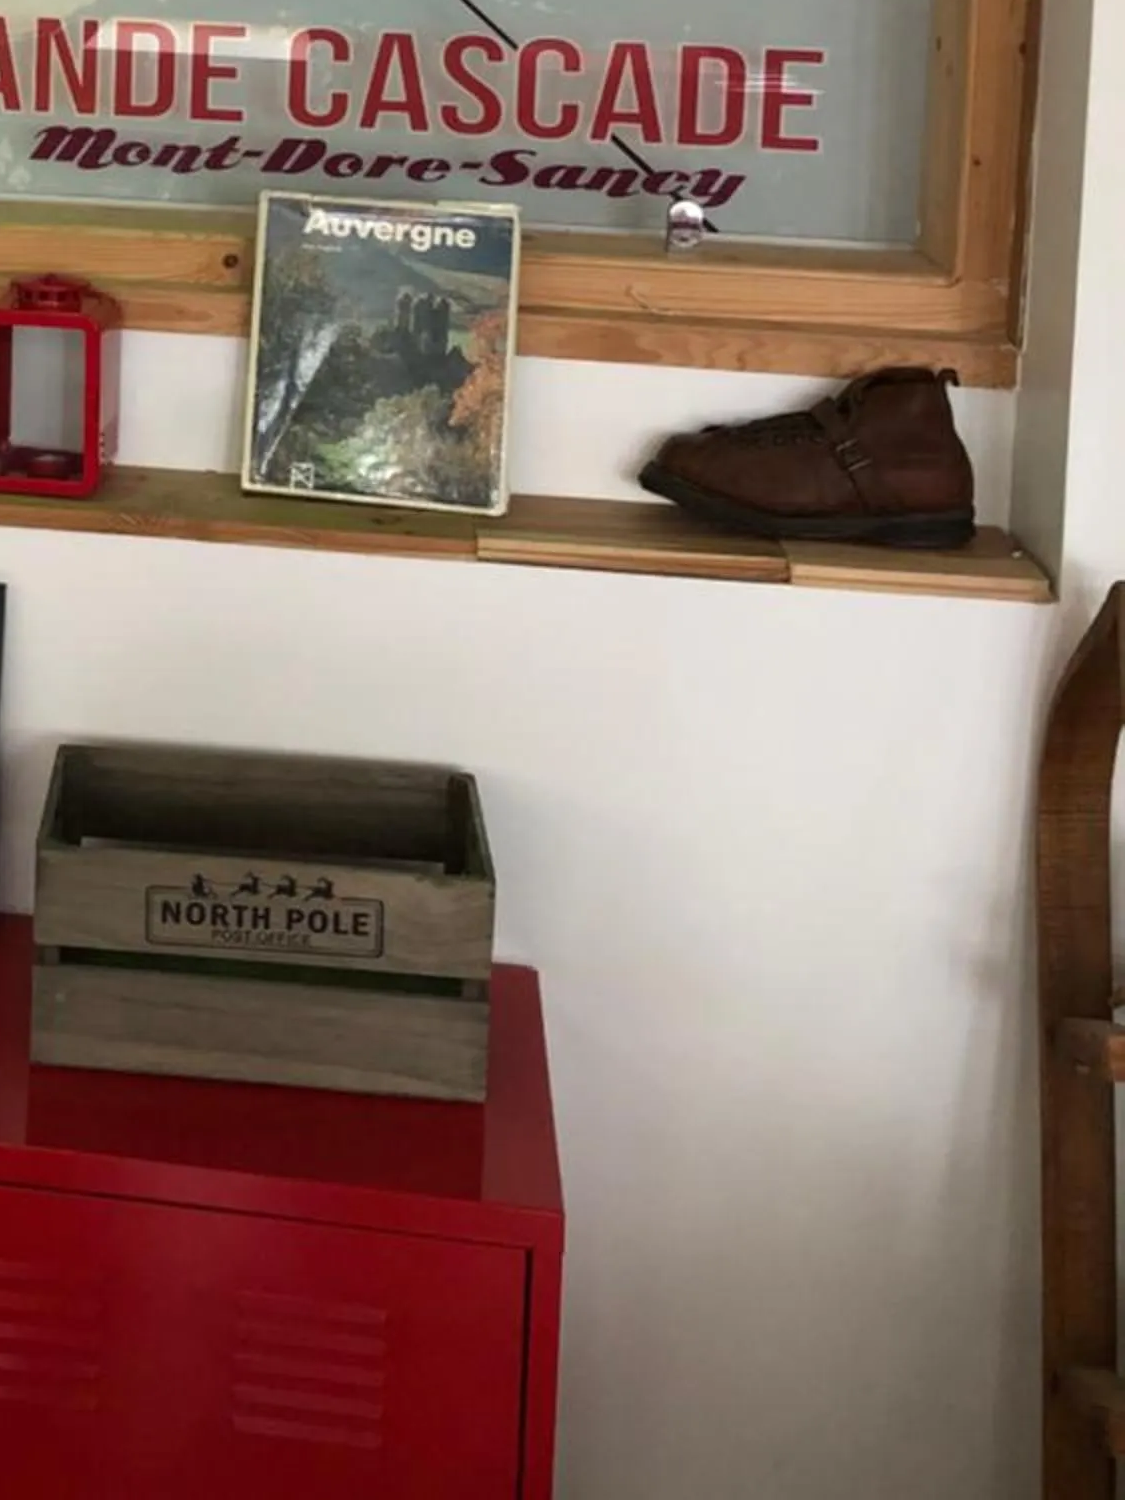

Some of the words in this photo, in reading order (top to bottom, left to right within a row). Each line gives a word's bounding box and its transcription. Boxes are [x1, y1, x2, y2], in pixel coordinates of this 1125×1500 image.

[286, 27, 825, 152] CASCADE
[28, 124, 746, 207] Mont-Dore-Sancy
[303, 209, 476, 251] Auvergne
[160, 900, 271, 930] NORTH
[286, 909, 371, 936] POLE
[211, 929, 252, 945] POST
[255, 931, 311, 948] OFFICE
